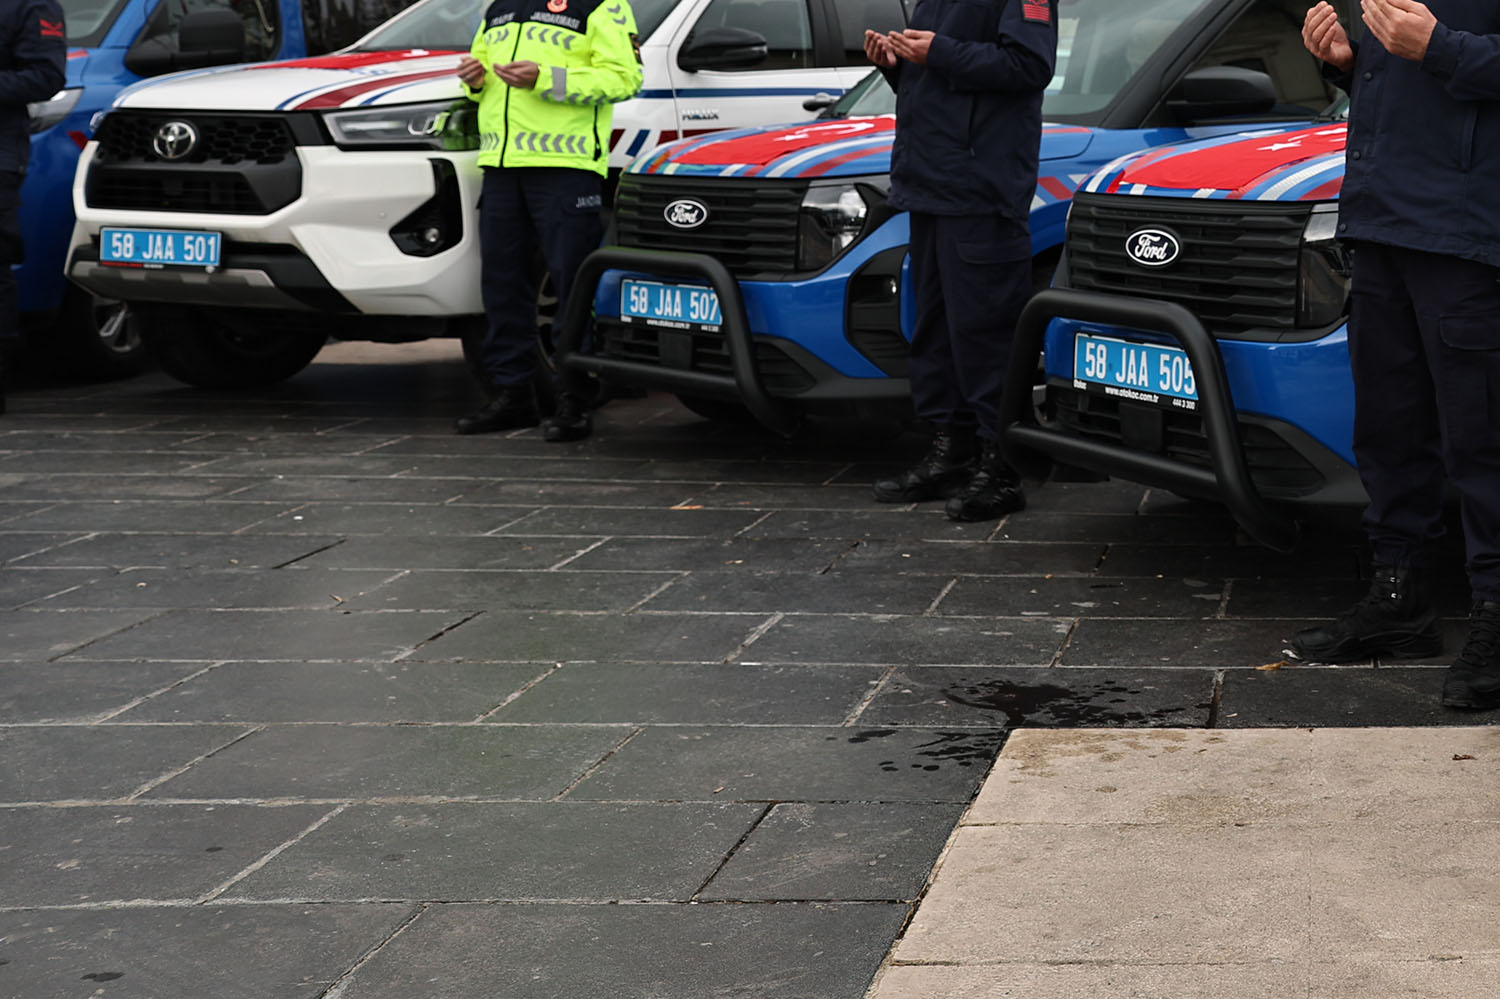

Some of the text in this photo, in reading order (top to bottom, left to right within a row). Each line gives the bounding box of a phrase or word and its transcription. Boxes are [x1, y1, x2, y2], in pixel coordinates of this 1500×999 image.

[112, 232, 216, 262] 58 JAA 501
[630, 286, 719, 321] 58 JAA 507
[1085, 342, 1196, 395] 58 JAA 505
[1105, 386, 1159, 403] www.otokoc.com.tr
